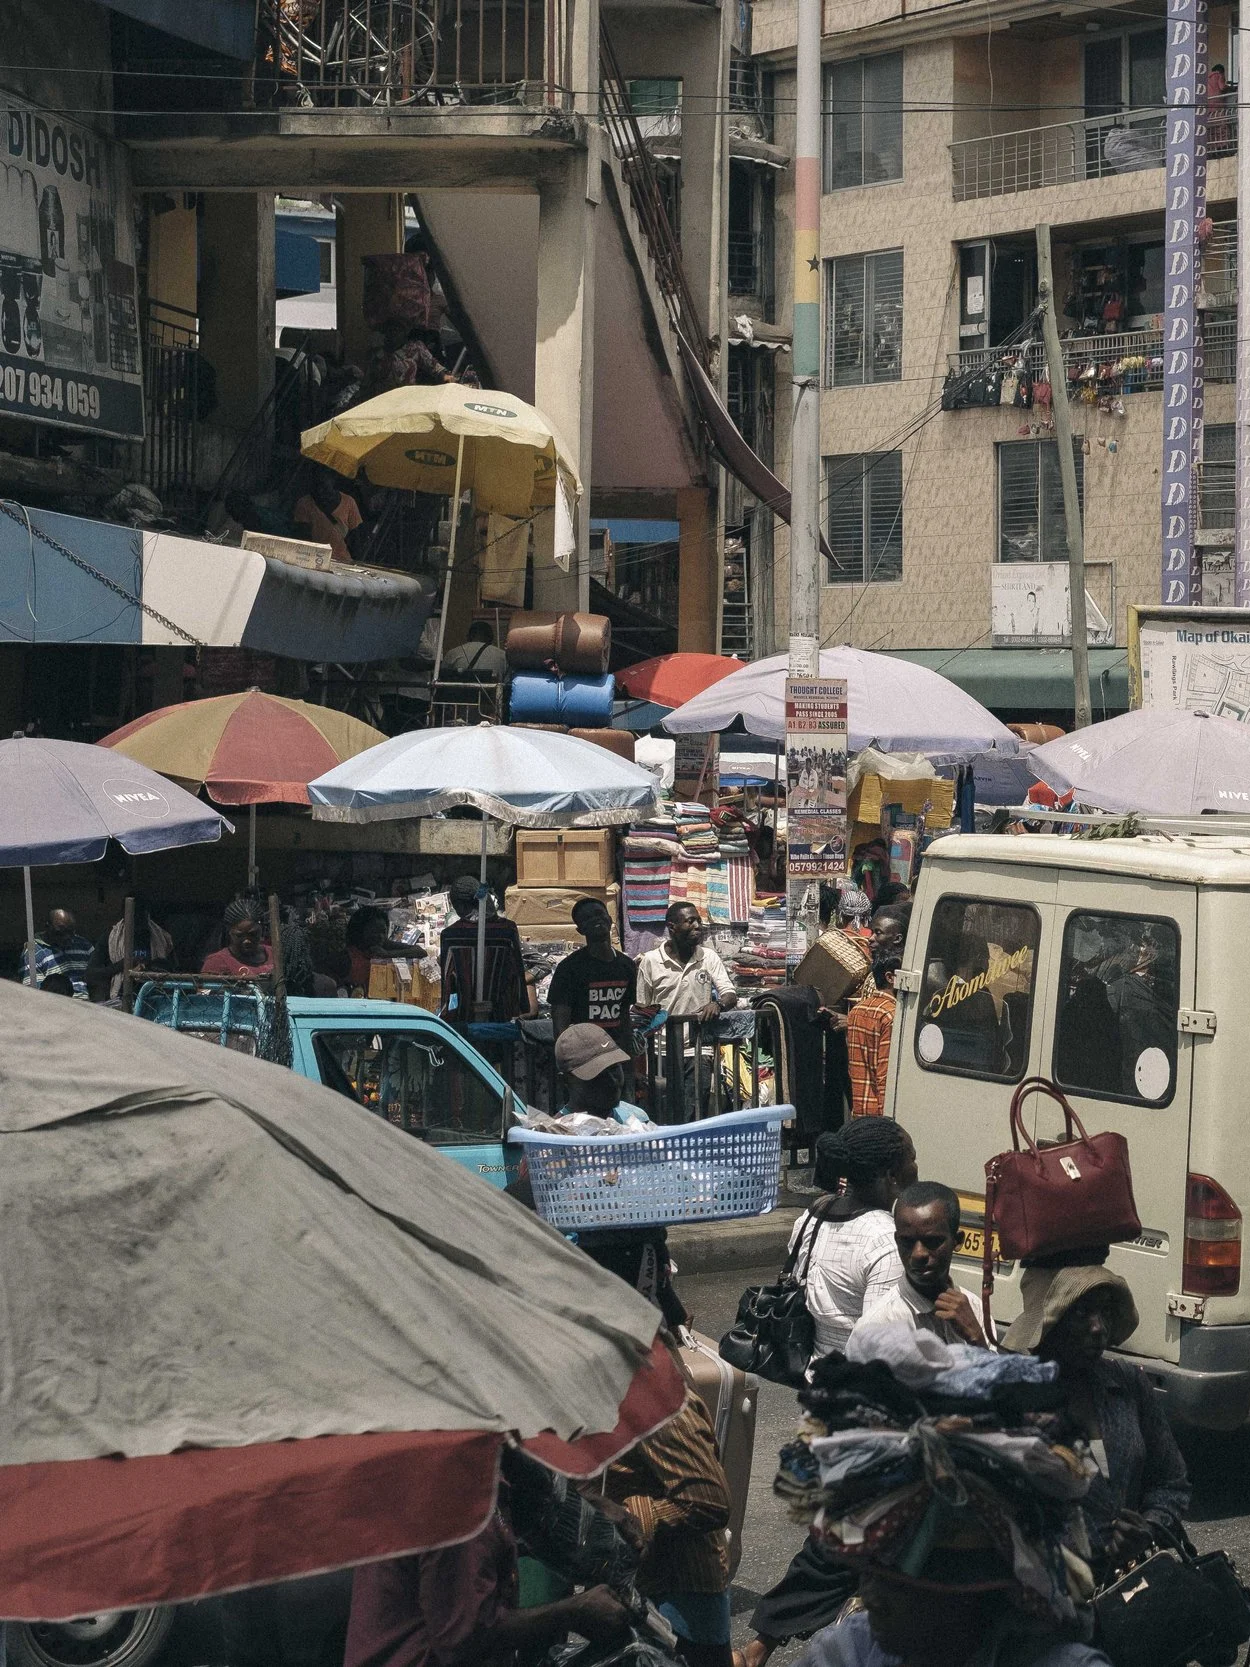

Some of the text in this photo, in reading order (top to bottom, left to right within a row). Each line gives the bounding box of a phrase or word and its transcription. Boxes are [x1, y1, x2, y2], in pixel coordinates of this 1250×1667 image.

[29, 371, 64, 411] 934
[66, 380, 100, 419] 059
[474, 404, 507, 416] MTN
[1176, 630, 1204, 644] Map
[1206, 630, 1220, 643] of
[790, 686, 842, 696] THOUGHT COLLEGE
[794, 702, 814, 710] MAKING
[818, 721, 846, 729] ASSURED
[114, 792, 160, 802] NIVEA
[790, 862, 844, 872] 0579921424
